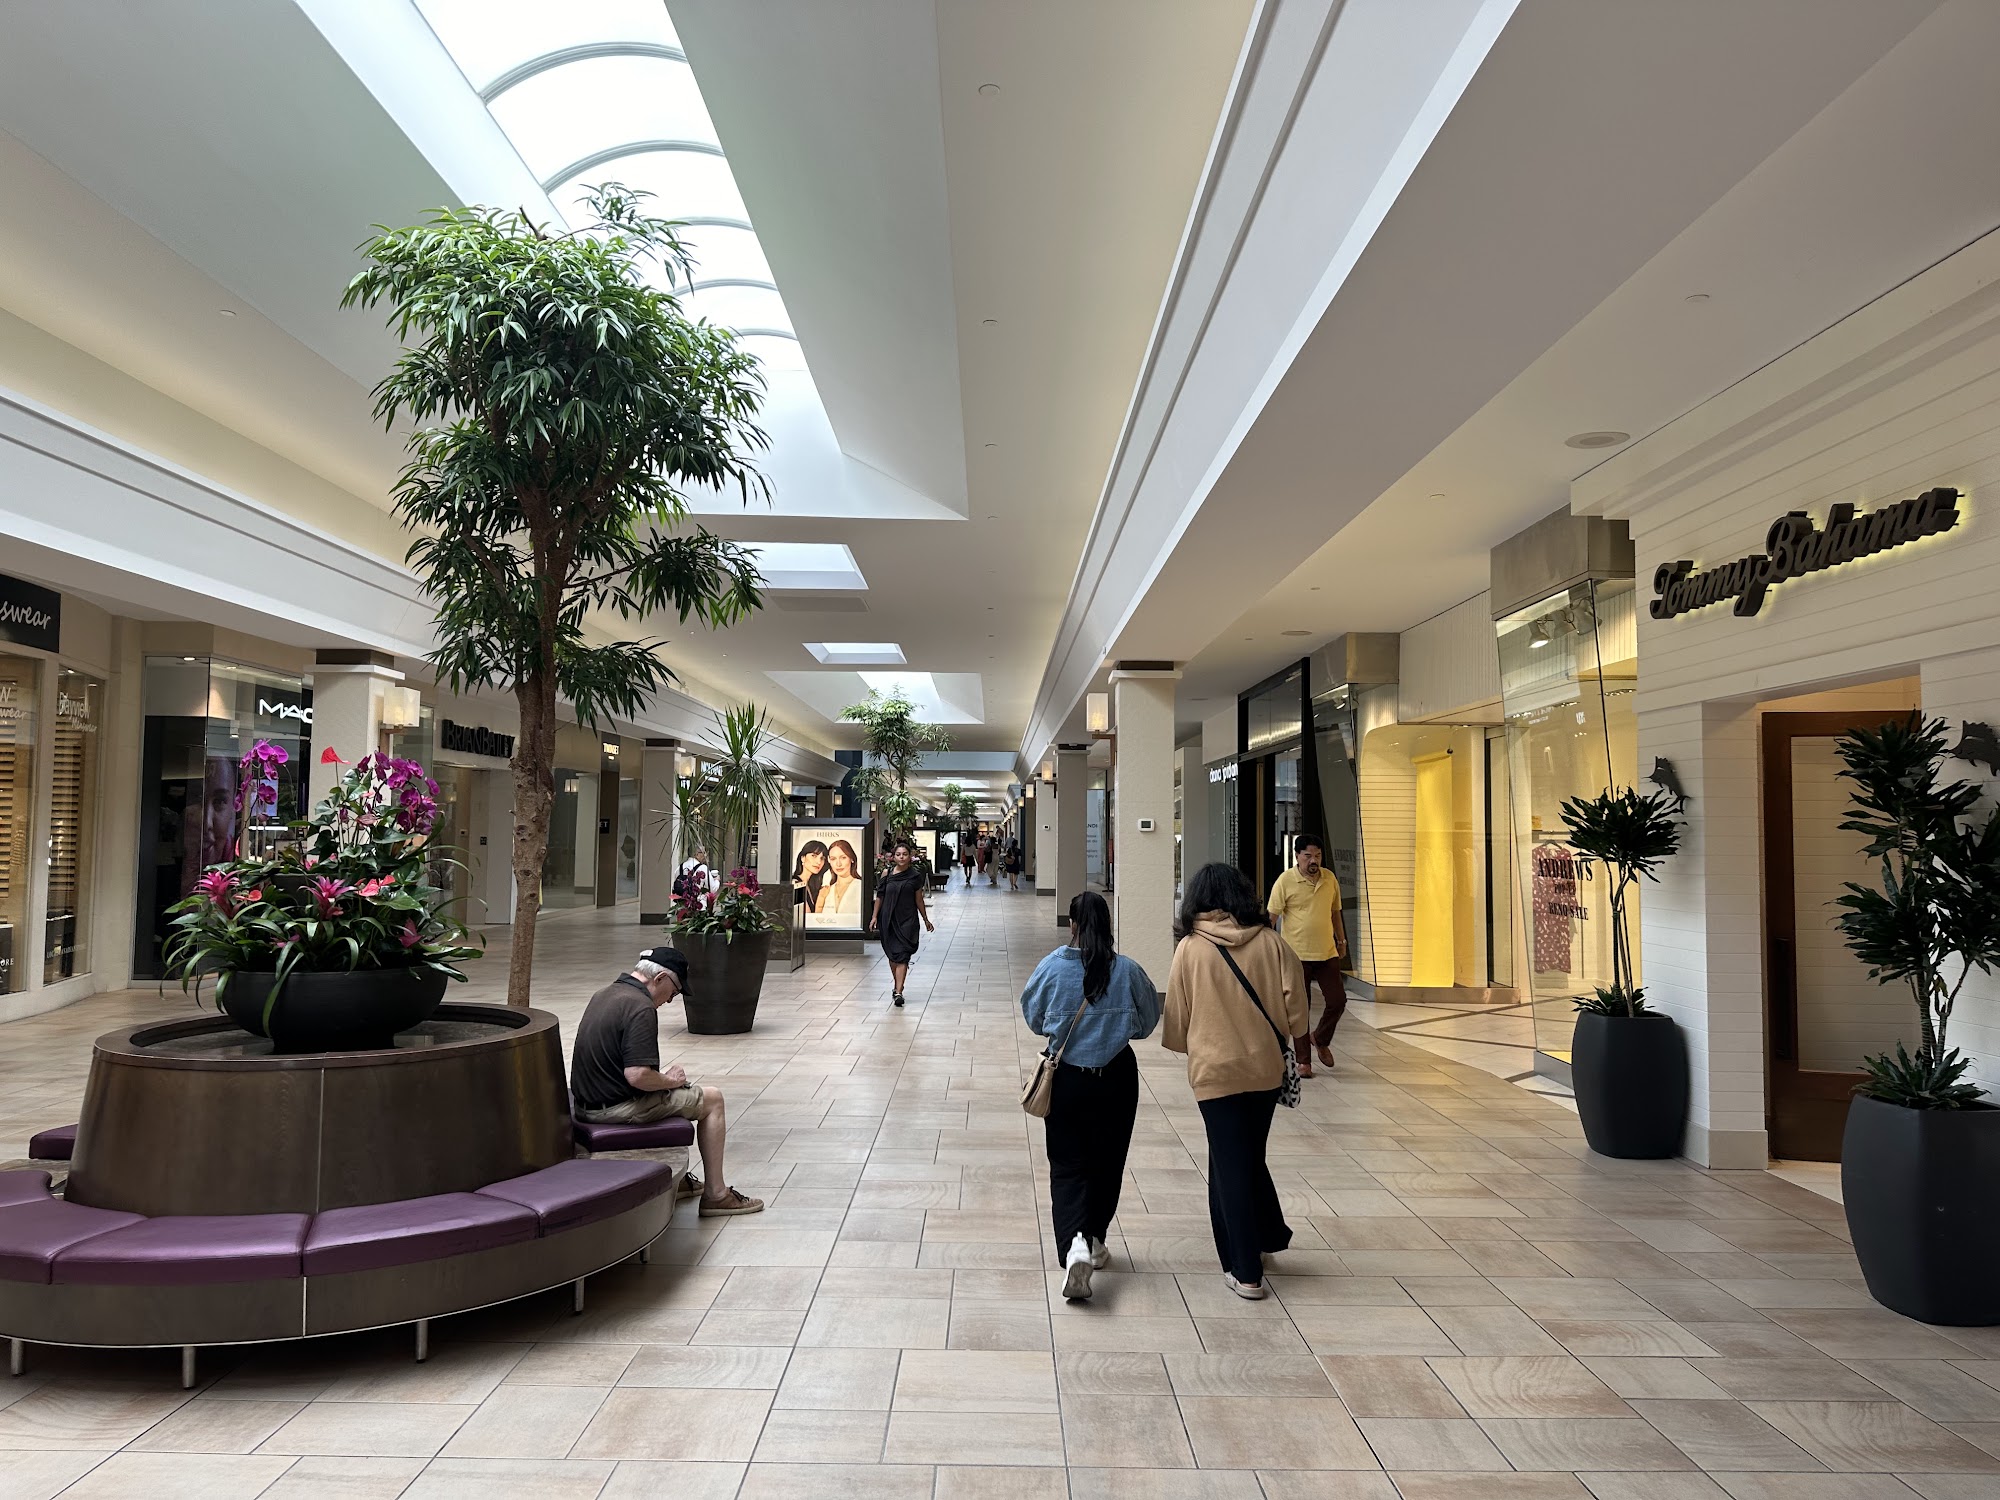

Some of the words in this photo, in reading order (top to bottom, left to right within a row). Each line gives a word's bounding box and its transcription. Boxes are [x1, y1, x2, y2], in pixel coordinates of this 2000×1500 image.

[1650, 560, 1768, 619] Tommy
[1755, 487, 1960, 584] Bahama
[1548, 901, 1568, 917] RENO
[1569, 904, 1589, 921] SALE
